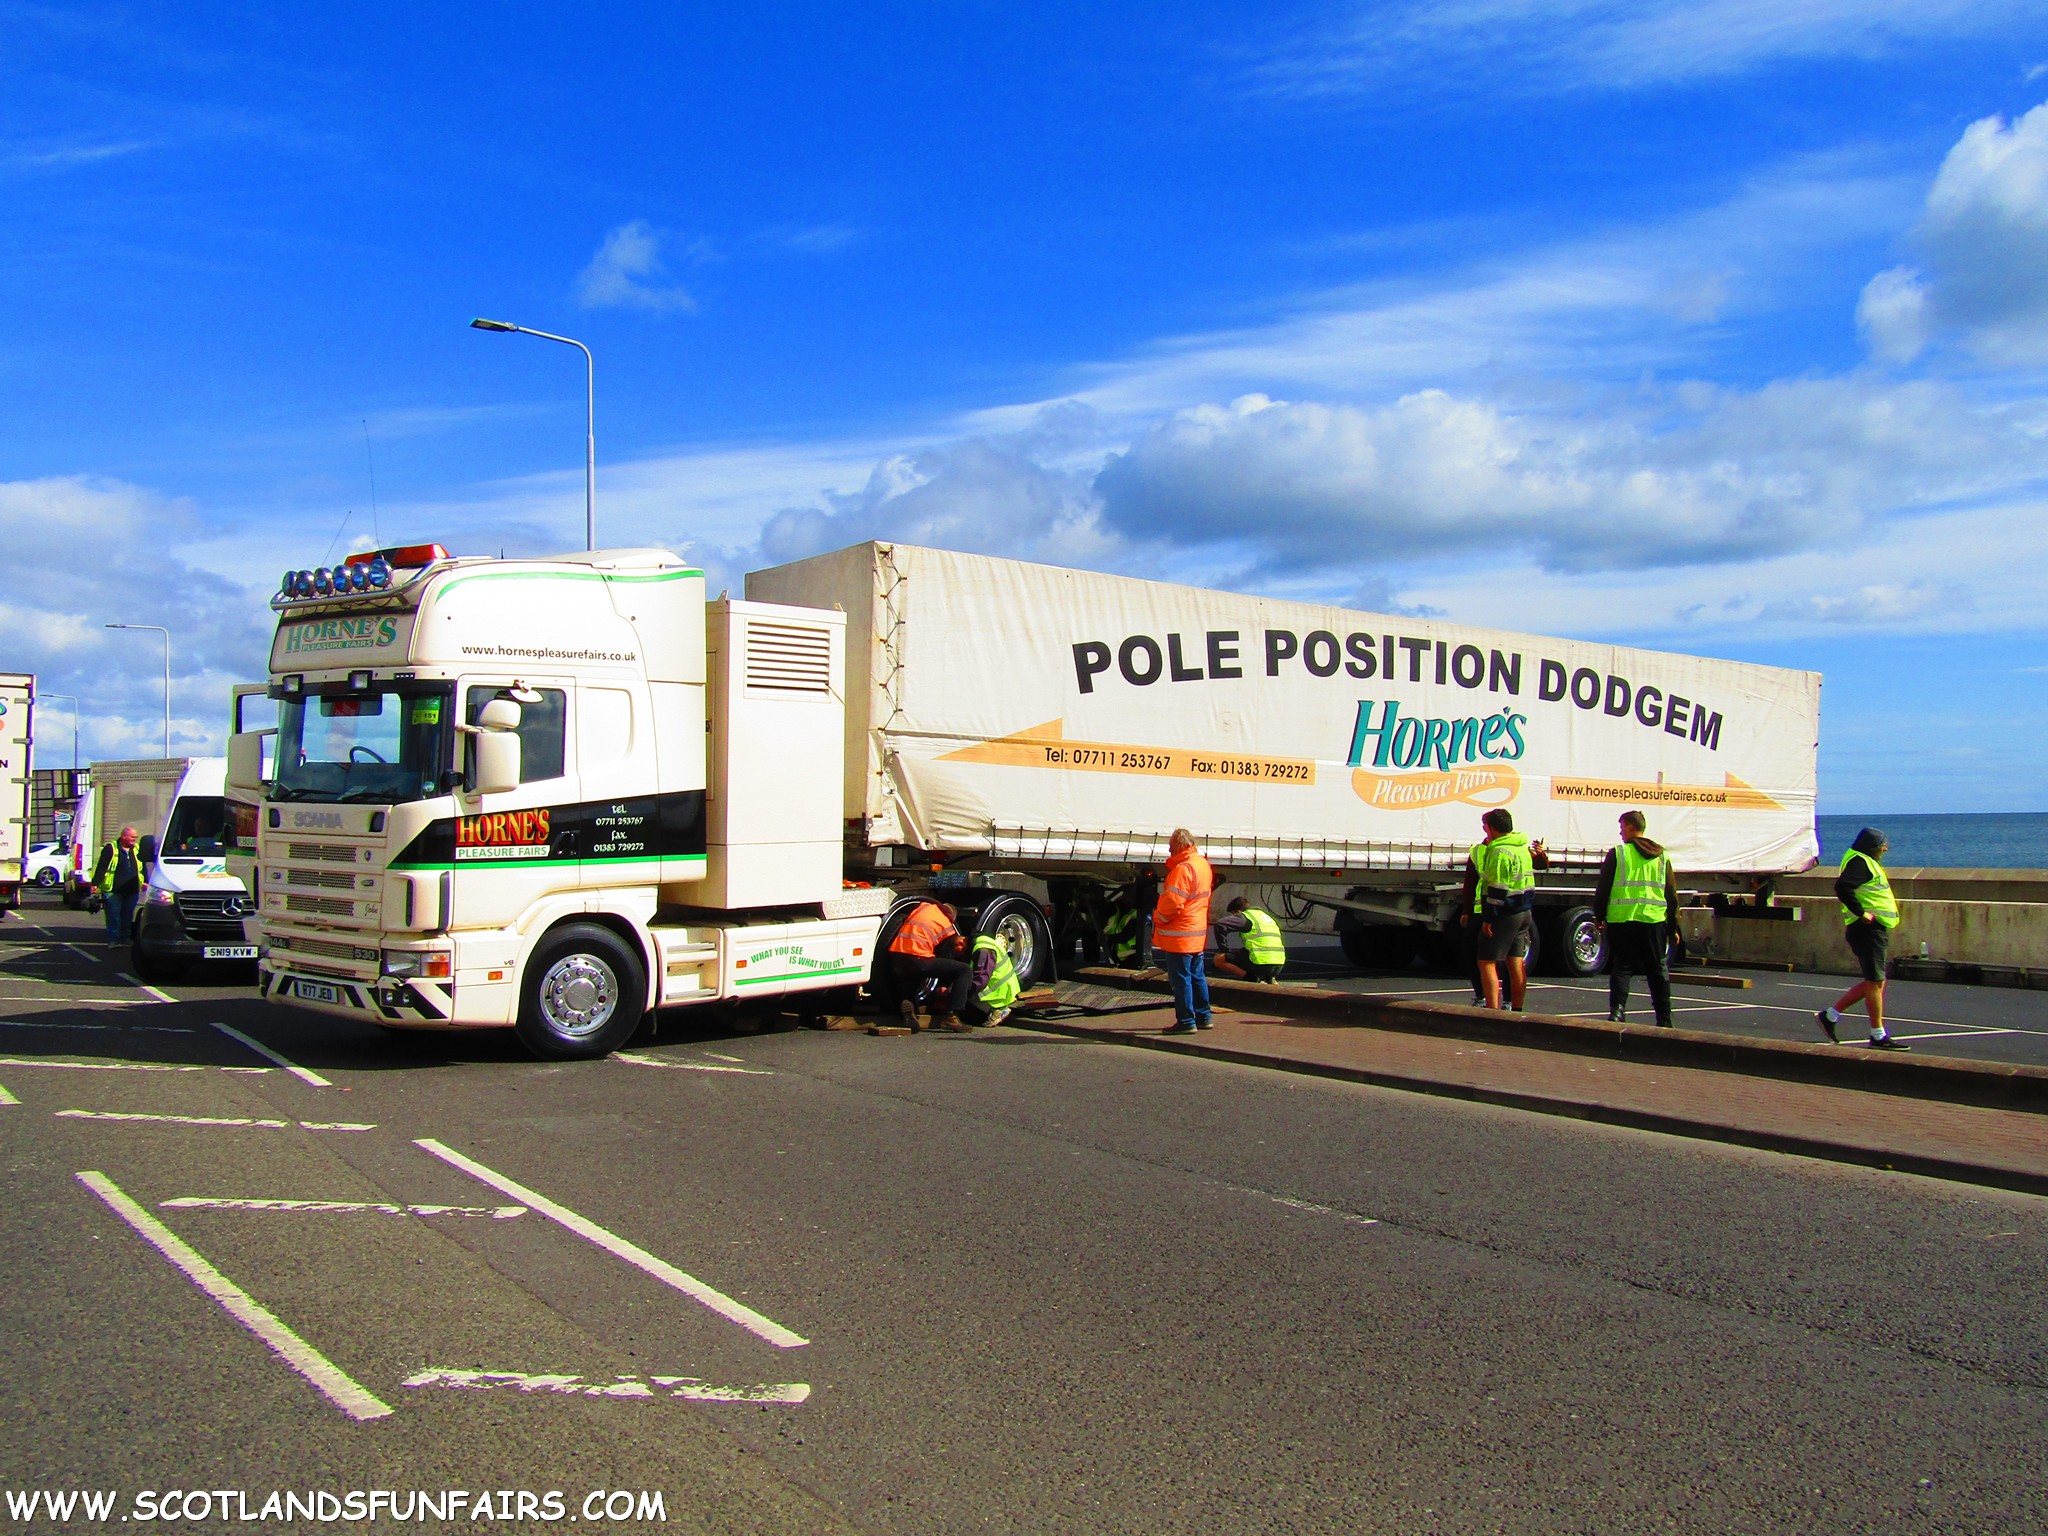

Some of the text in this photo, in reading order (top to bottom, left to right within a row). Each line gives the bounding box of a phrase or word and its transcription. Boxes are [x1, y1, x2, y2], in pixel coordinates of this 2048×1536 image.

[284, 616, 398, 654] HORNE'S
[345, 640, 372, 649] FAIRS
[461, 645, 636, 662] www.hornespleasurefairs.co.uk
[1072, 629, 1724, 751] POLE POSITION DODGEM
[1045, 748, 1308, 779] Tel: 07711 253767 Fax: 01383 729272
[1372, 769, 1497, 804] Pleasure Fairs
[1556, 785, 1727, 803] www.hornespleasurefaires.co.uk
[294, 811, 343, 828] SCANIA
[456, 808, 550, 846] HORNE'S
[596, 816, 644, 826] 07711 253767
[458, 845, 547, 858] PLEASURE FAIRS
[594, 842, 645, 852] 01383 729272
[354, 949, 375, 960] 530
[751, 945, 804, 963] WHAT YOU SEE
[789, 955, 846, 970] IS WHAT YOU GET
